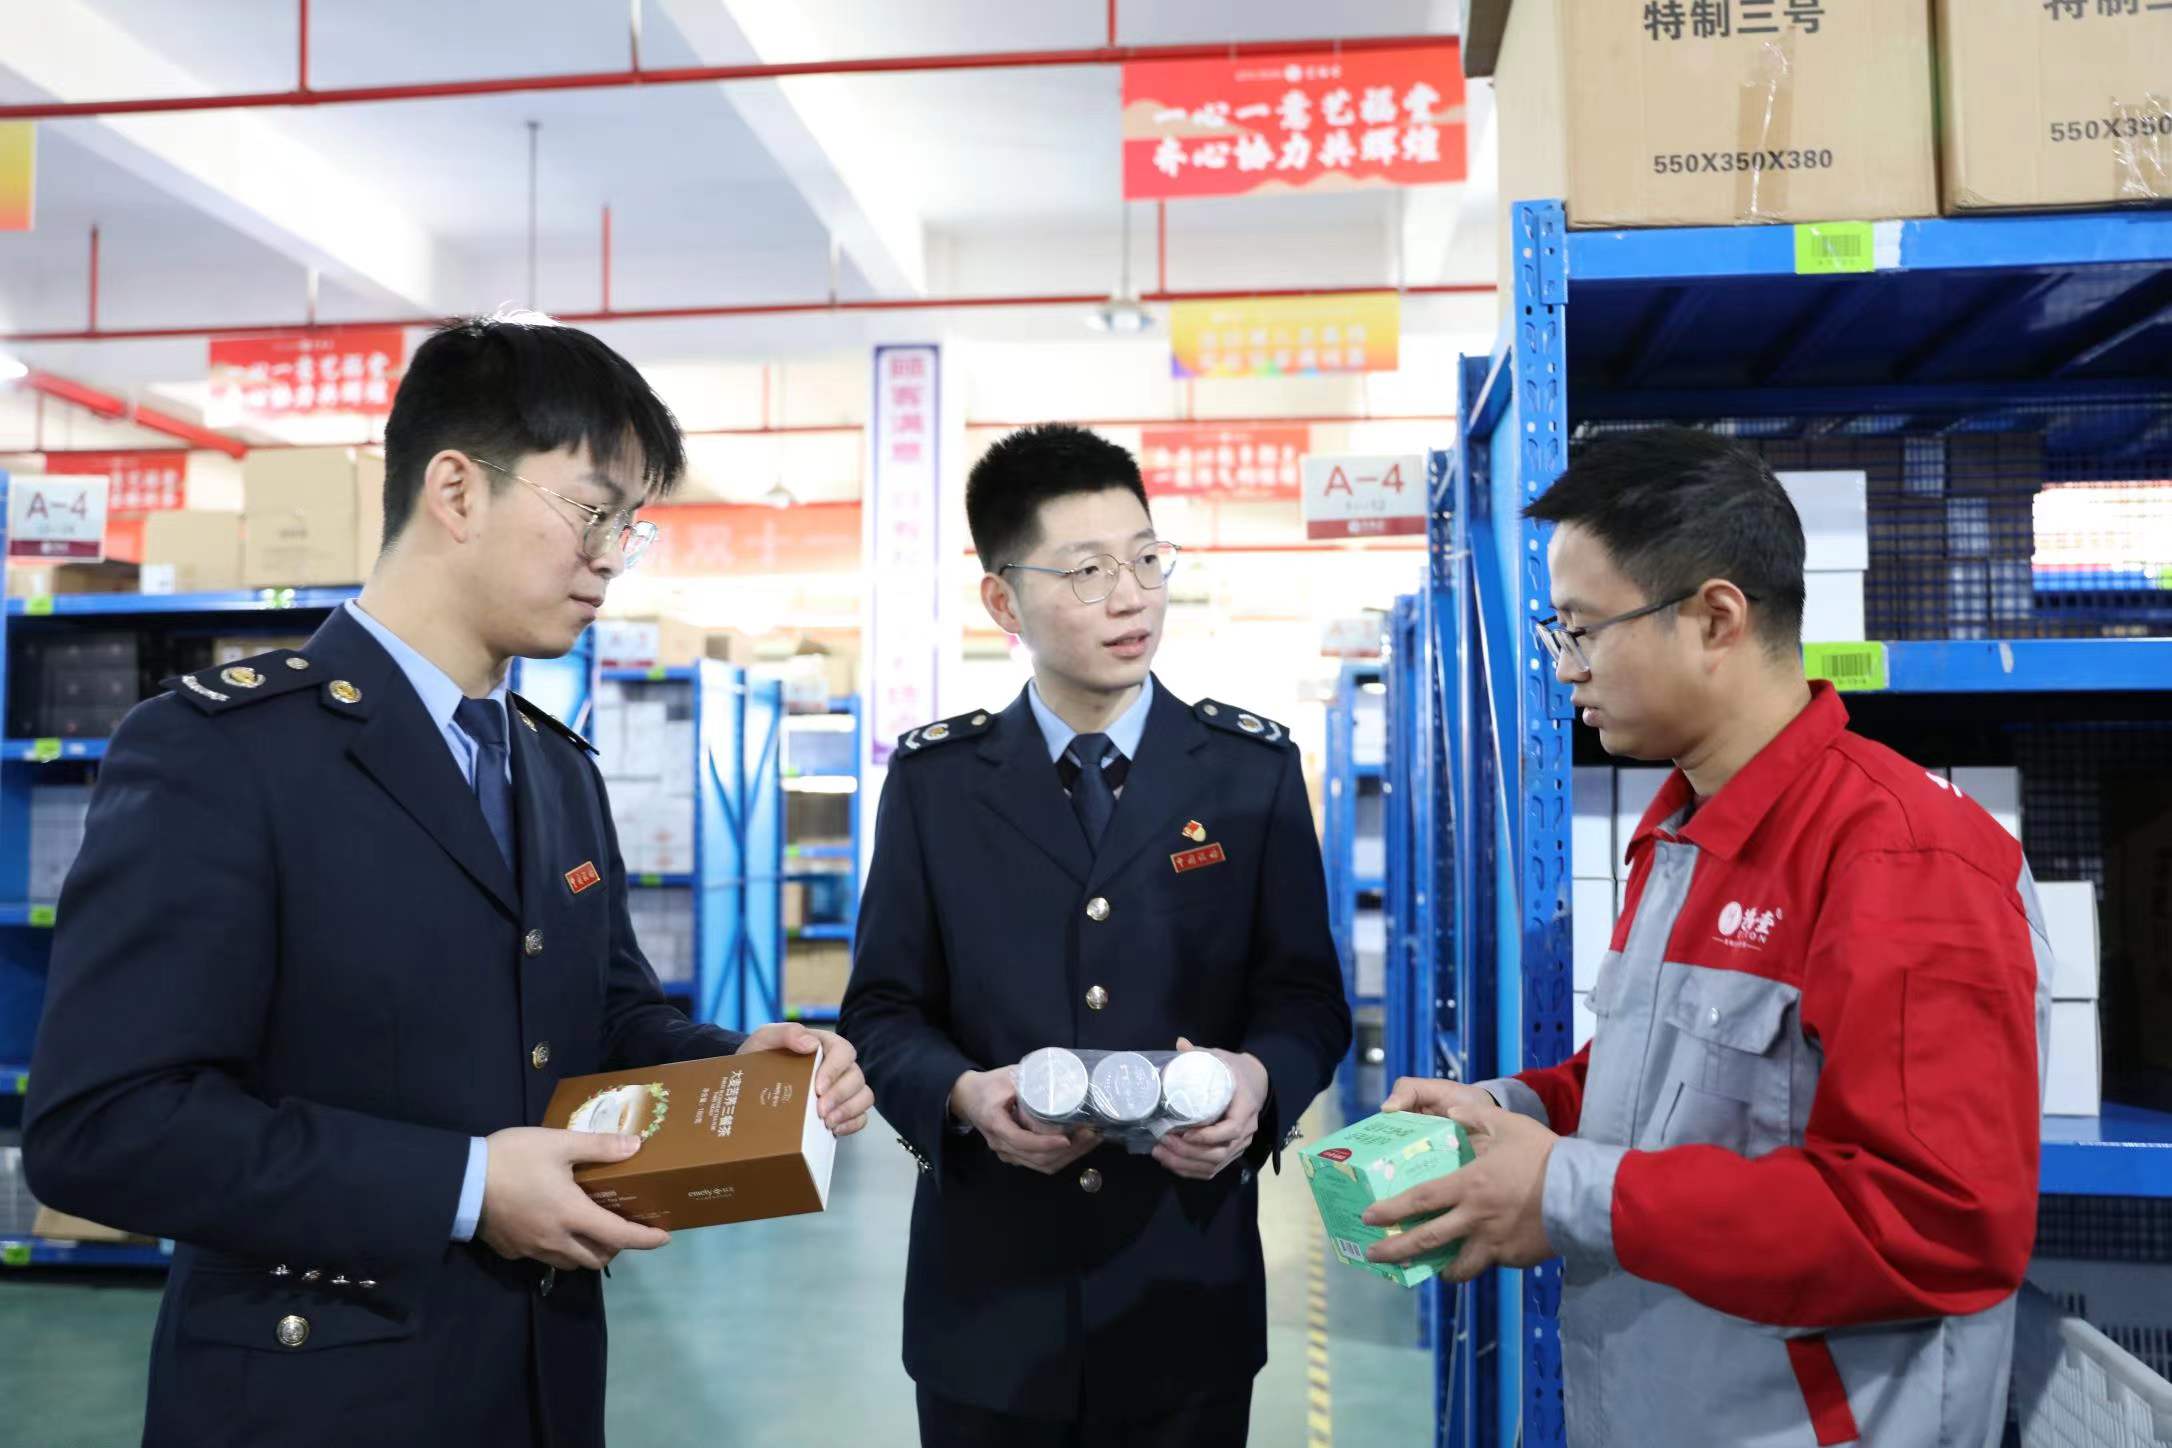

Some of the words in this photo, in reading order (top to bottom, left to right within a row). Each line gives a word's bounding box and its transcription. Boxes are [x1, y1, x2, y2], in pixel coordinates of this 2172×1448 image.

[1643, 0, 1825, 41] 特制三号
[1153, 82, 1441, 131] 一心一意艺福堂
[1152, 126, 1441, 178] 齐心协力共辉煌
[1652, 148, 1834, 175] 550X350X380
